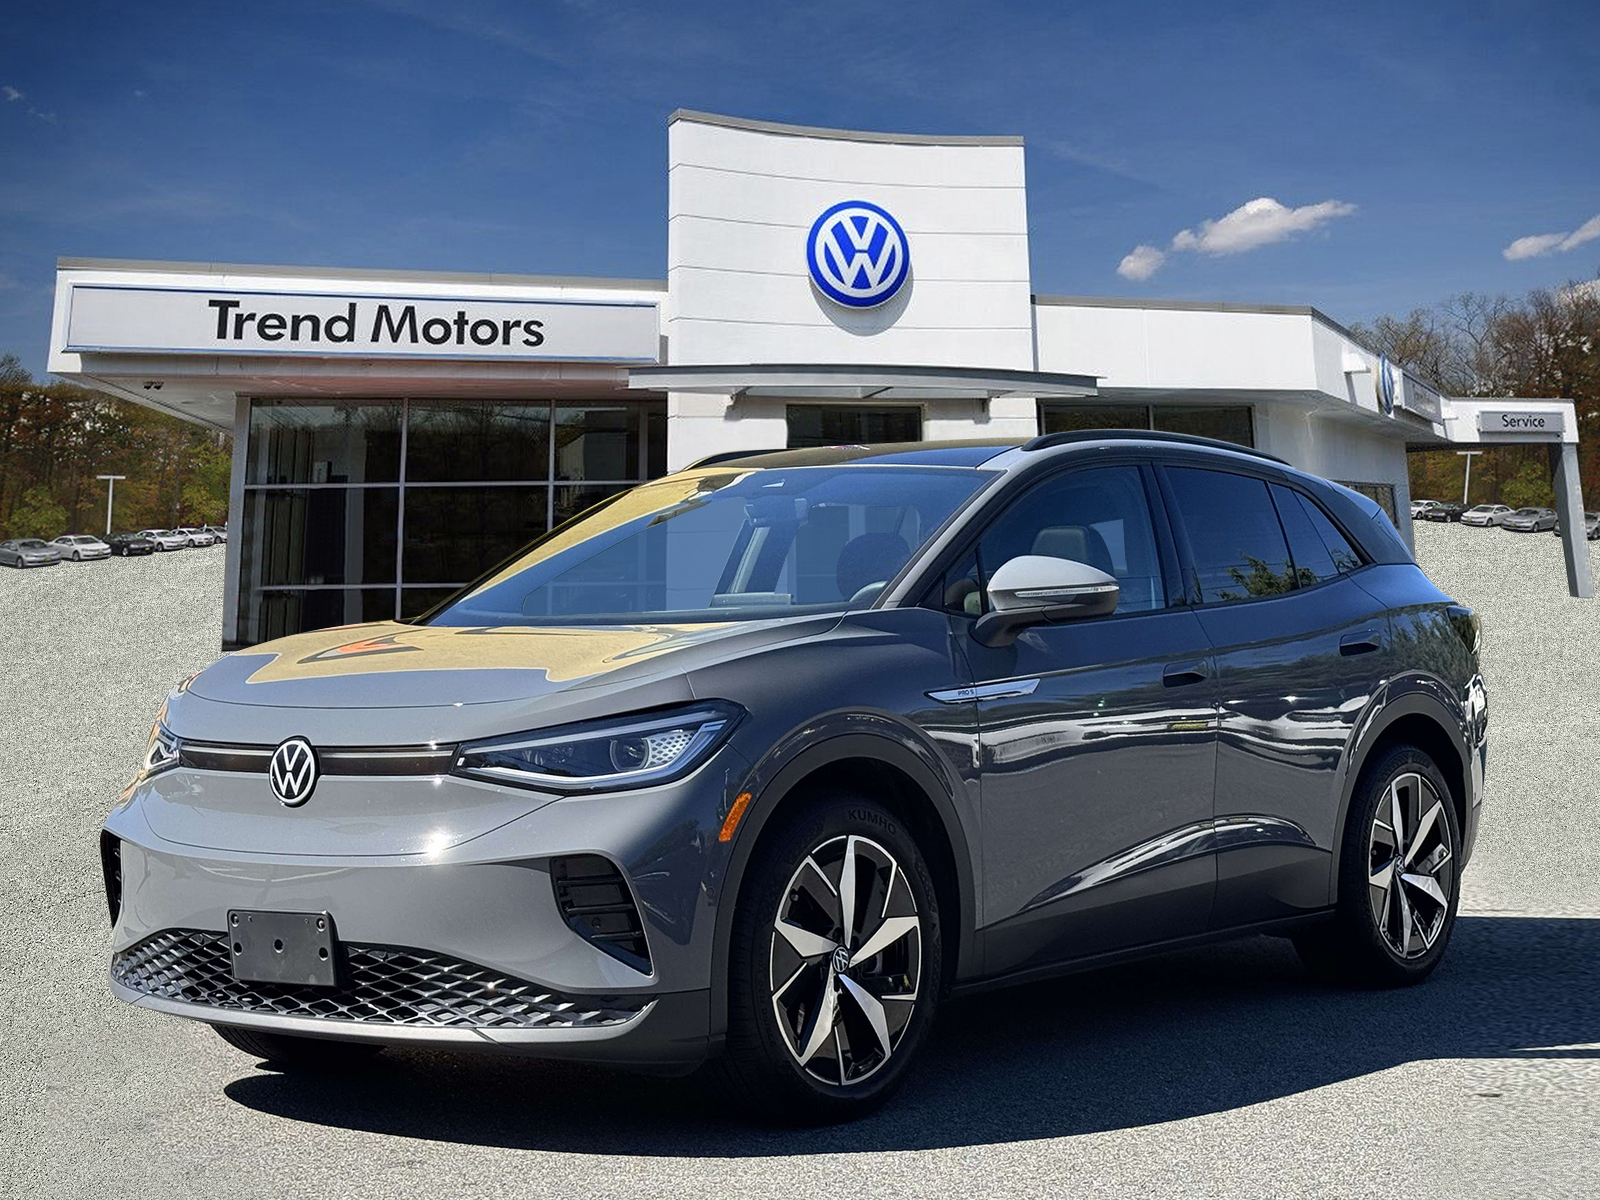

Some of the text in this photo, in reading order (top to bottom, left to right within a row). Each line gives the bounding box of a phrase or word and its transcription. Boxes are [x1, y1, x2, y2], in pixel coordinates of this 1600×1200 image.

[812, 205, 904, 299] VW
[208, 299, 546, 347] Trend Motors
[1501, 414, 1546, 428] Service
[269, 739, 316, 804] VW
[847, 809, 897, 835] KUMHO
